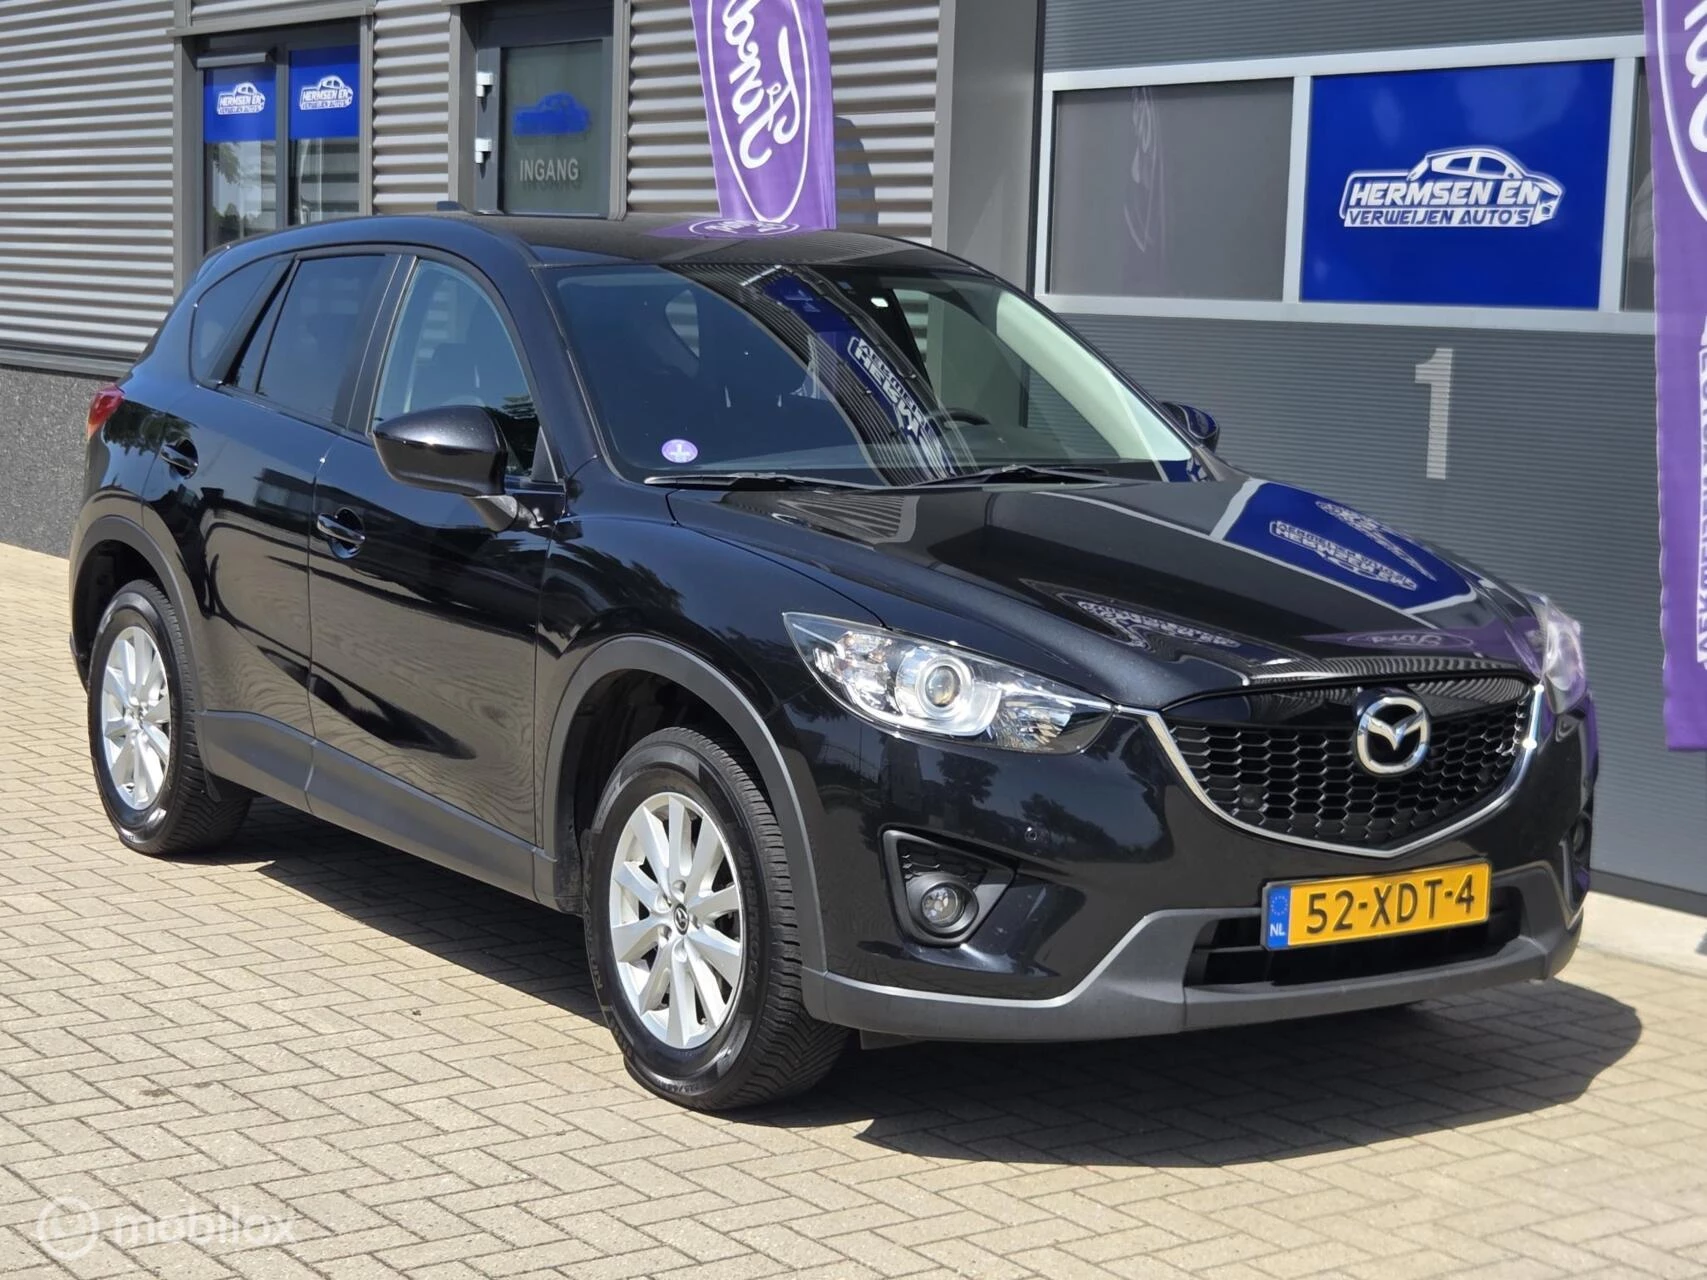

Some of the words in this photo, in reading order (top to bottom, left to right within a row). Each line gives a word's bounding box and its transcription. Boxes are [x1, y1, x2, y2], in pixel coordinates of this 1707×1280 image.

[519, 158, 579, 182] INGANG
[1349, 180, 1493, 206] HERMSEN
[1496, 180, 1541, 206] EN
[1349, 209, 1455, 226] VERWEIJEN
[1457, 209, 1532, 225] AUTO'S
[1414, 348, 1453, 481] 1
[1306, 872, 1475, 935] 52-XDT-4
[1269, 923, 1286, 937] NL
